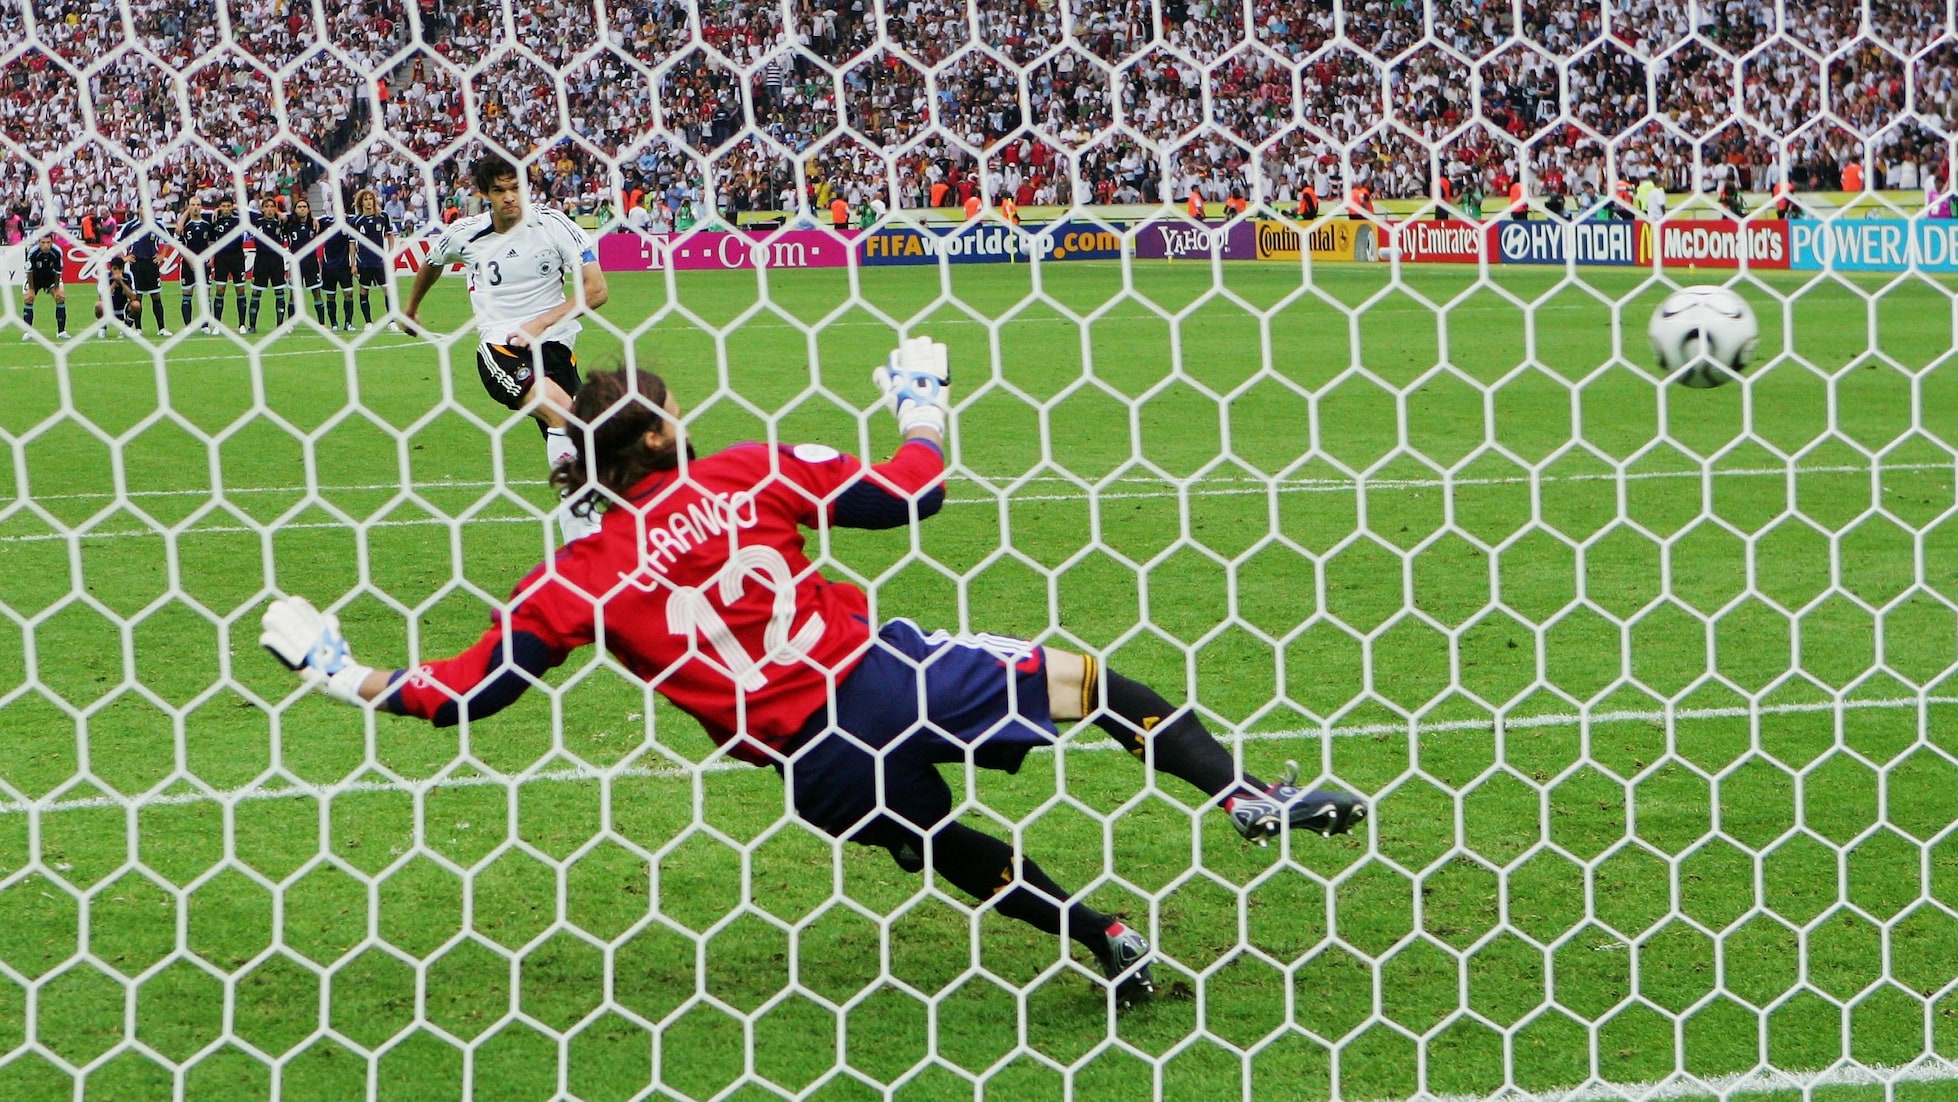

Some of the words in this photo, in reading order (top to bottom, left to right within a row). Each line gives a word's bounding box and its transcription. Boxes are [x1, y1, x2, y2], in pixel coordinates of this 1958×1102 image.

[1158, 226, 1230, 256] YAHOO!
[1259, 224, 1336, 257] Continntal
[1418, 221, 1479, 254] Emirates
[1532, 224, 1632, 261] HYUNDAI
[1792, 223, 1958, 266] POWERADE
[665, 544, 826, 692] 12
